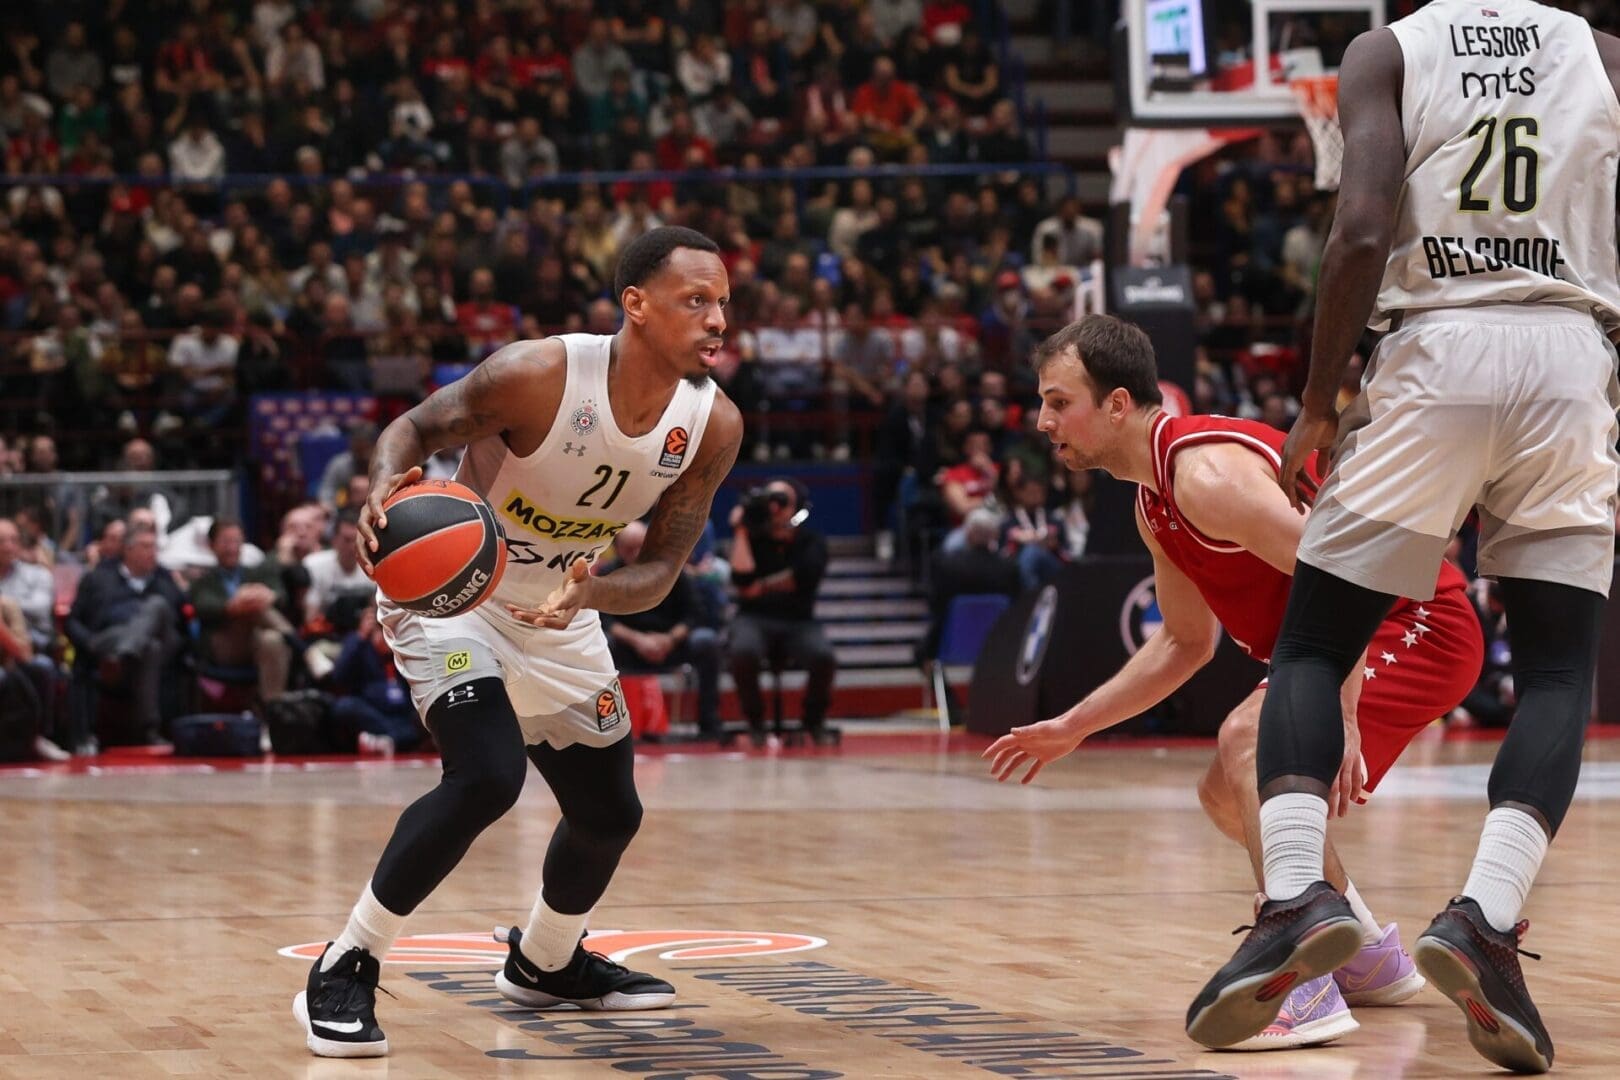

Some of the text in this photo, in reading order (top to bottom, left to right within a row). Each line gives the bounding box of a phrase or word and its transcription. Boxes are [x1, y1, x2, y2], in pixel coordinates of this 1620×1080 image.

[1450, 24, 1541, 58] LESSORT
[1461, 66, 1536, 99] mts
[1457, 115, 1540, 214] 26
[576, 464, 631, 510] 21
[505, 496, 628, 539] MOZZAR
[408, 568, 489, 617] PALDING
[669, 961, 1241, 1080] TURKISH AIRLI
